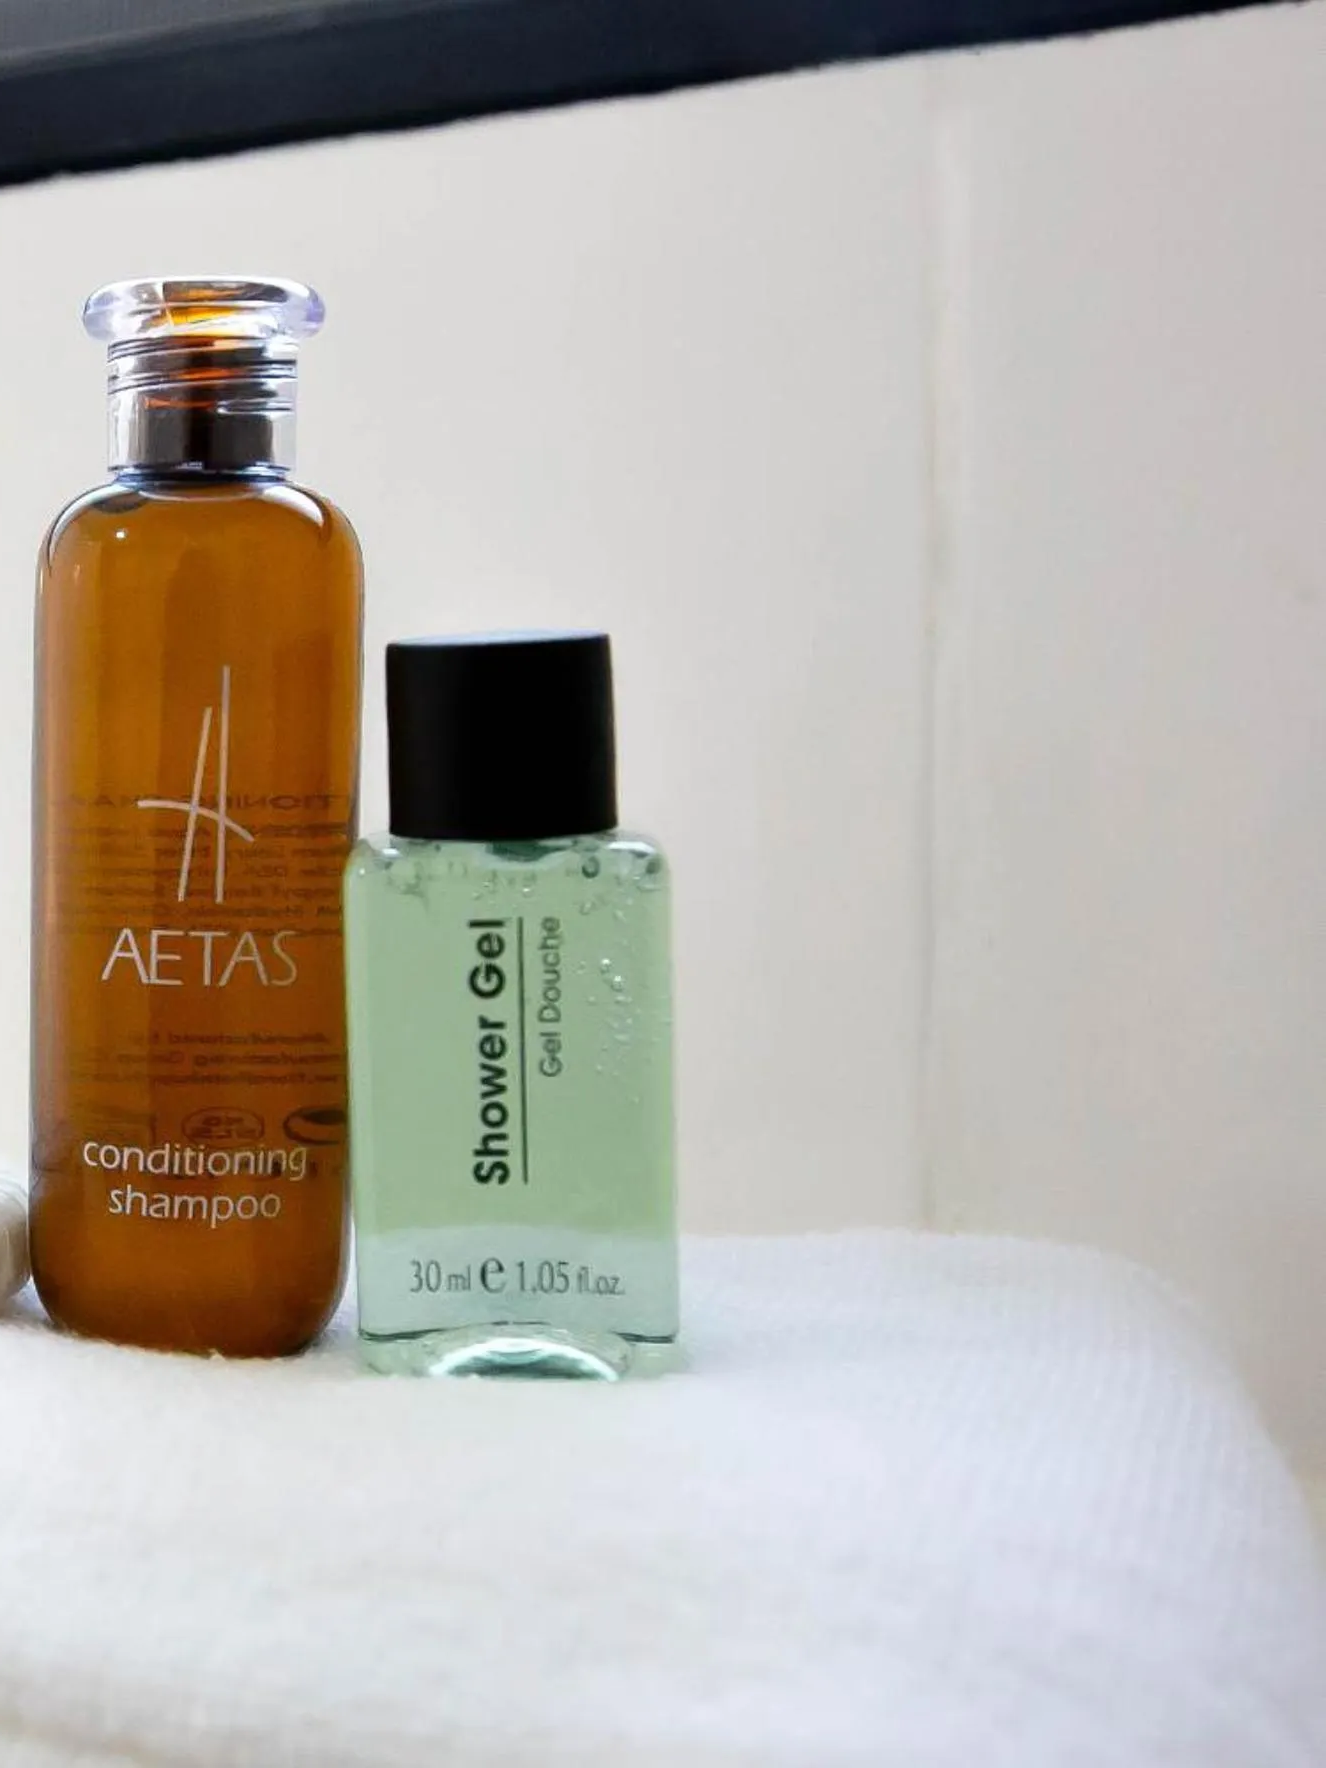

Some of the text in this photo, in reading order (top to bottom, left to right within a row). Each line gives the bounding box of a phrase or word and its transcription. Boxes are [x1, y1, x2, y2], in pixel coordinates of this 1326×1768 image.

[101, 927, 299, 986] AETAS
[537, 916, 563, 1078] Gel Douche
[466, 918, 511, 1186] Shower Gel
[82, 1141, 308, 1182] conditioning
[107, 1184, 282, 1229] shampoo
[409, 1259, 443, 1294] 30
[447, 1264, 472, 1293] ml
[516, 1260, 571, 1294] 1.05
